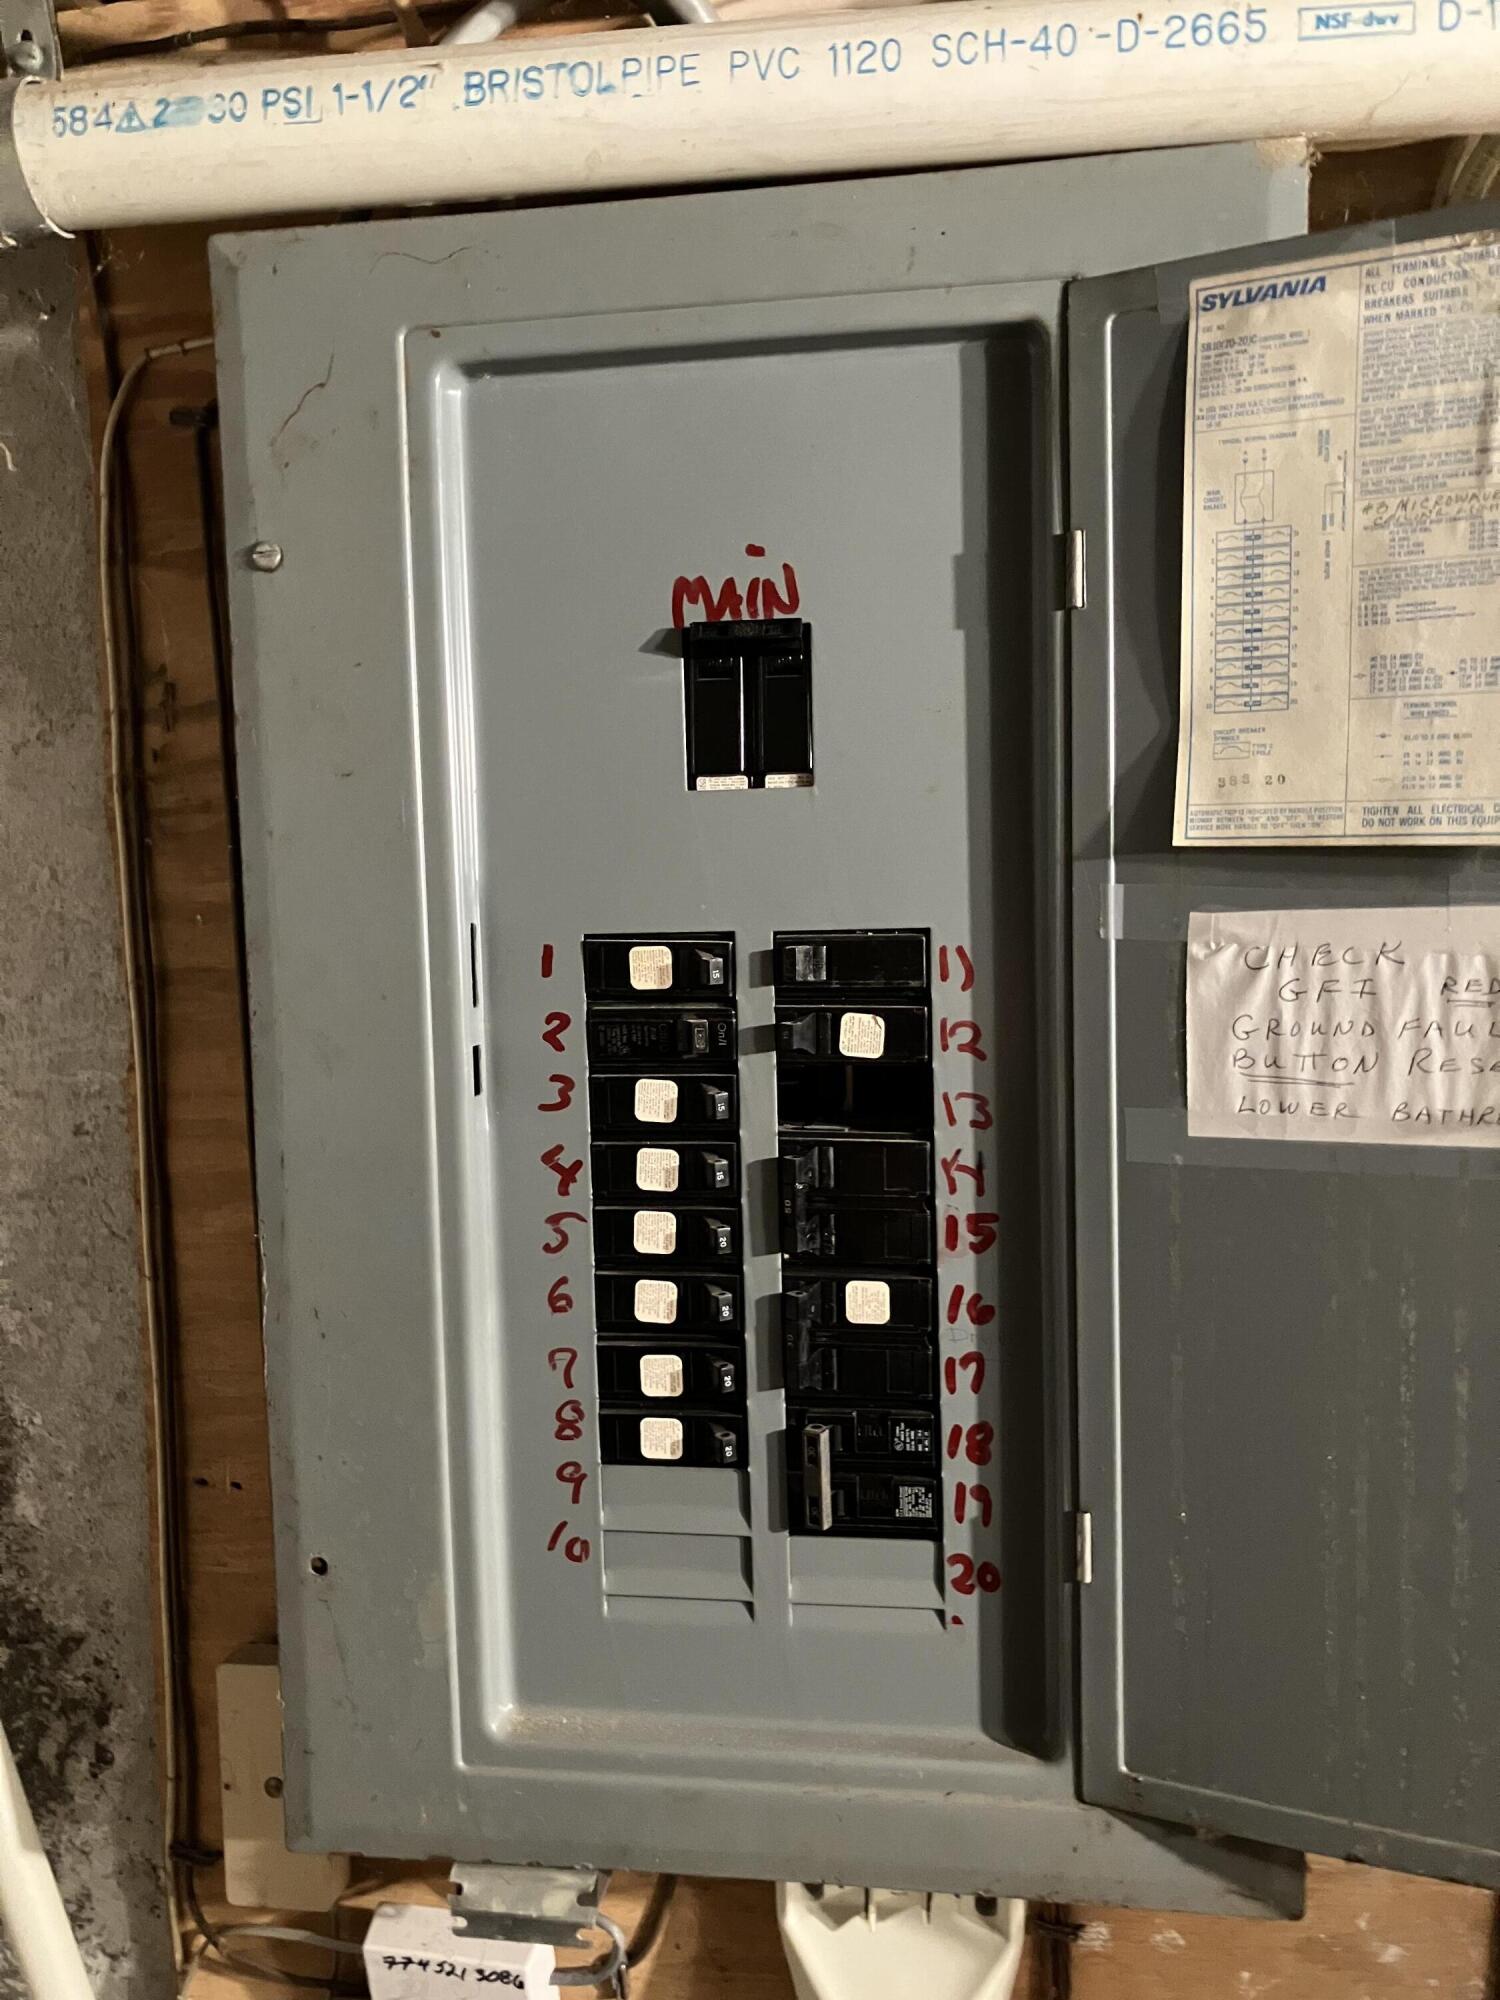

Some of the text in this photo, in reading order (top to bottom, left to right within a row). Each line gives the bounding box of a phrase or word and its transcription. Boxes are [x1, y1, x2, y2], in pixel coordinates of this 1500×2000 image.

[262, 85, 314, 120] PSI
[728, 46, 801, 85] PVC
[827, 38, 902, 77] 1120
[1200, 275, 1327, 312] SYLVANIA
[1377, 816, 1396, 828] NOT
[1399, 815, 1426, 827] WORK
[540, 943, 554, 979] 1
[938, 944, 976, 992] 11
[1244, 939, 1405, 971] CHECK
[1278, 975, 1500, 1003] GFI RED
[541, 1011, 572, 1053] 2
[940, 1016, 988, 1062] 12
[1231, 1014, 1376, 1041] GROUND
[1232, 1047, 1380, 1075] BUTTON
[536, 1073, 576, 1112] 3
[942, 1091, 993, 1130] 13
[1236, 1095, 1361, 1120] LOWER
[539, 1143, 583, 1197] 4
[541, 1211, 589, 1255] 5
[944, 1212, 1000, 1255] 15
[547, 1275, 574, 1314] 6
[946, 1283, 996, 1326] 16
[547, 1346, 578, 1389] 7
[944, 1350, 986, 1395] 17
[554, 1398, 586, 1441] 8
[946, 1419, 995, 1467] 18
[555, 1460, 588, 1505] 9
[953, 1481, 994, 1529] 19
[546, 1519, 591, 1563] 10
[946, 1552, 1002, 1596] 20
[382, 1955, 430, 1972] 774
[433, 1960, 467, 1981] 521
